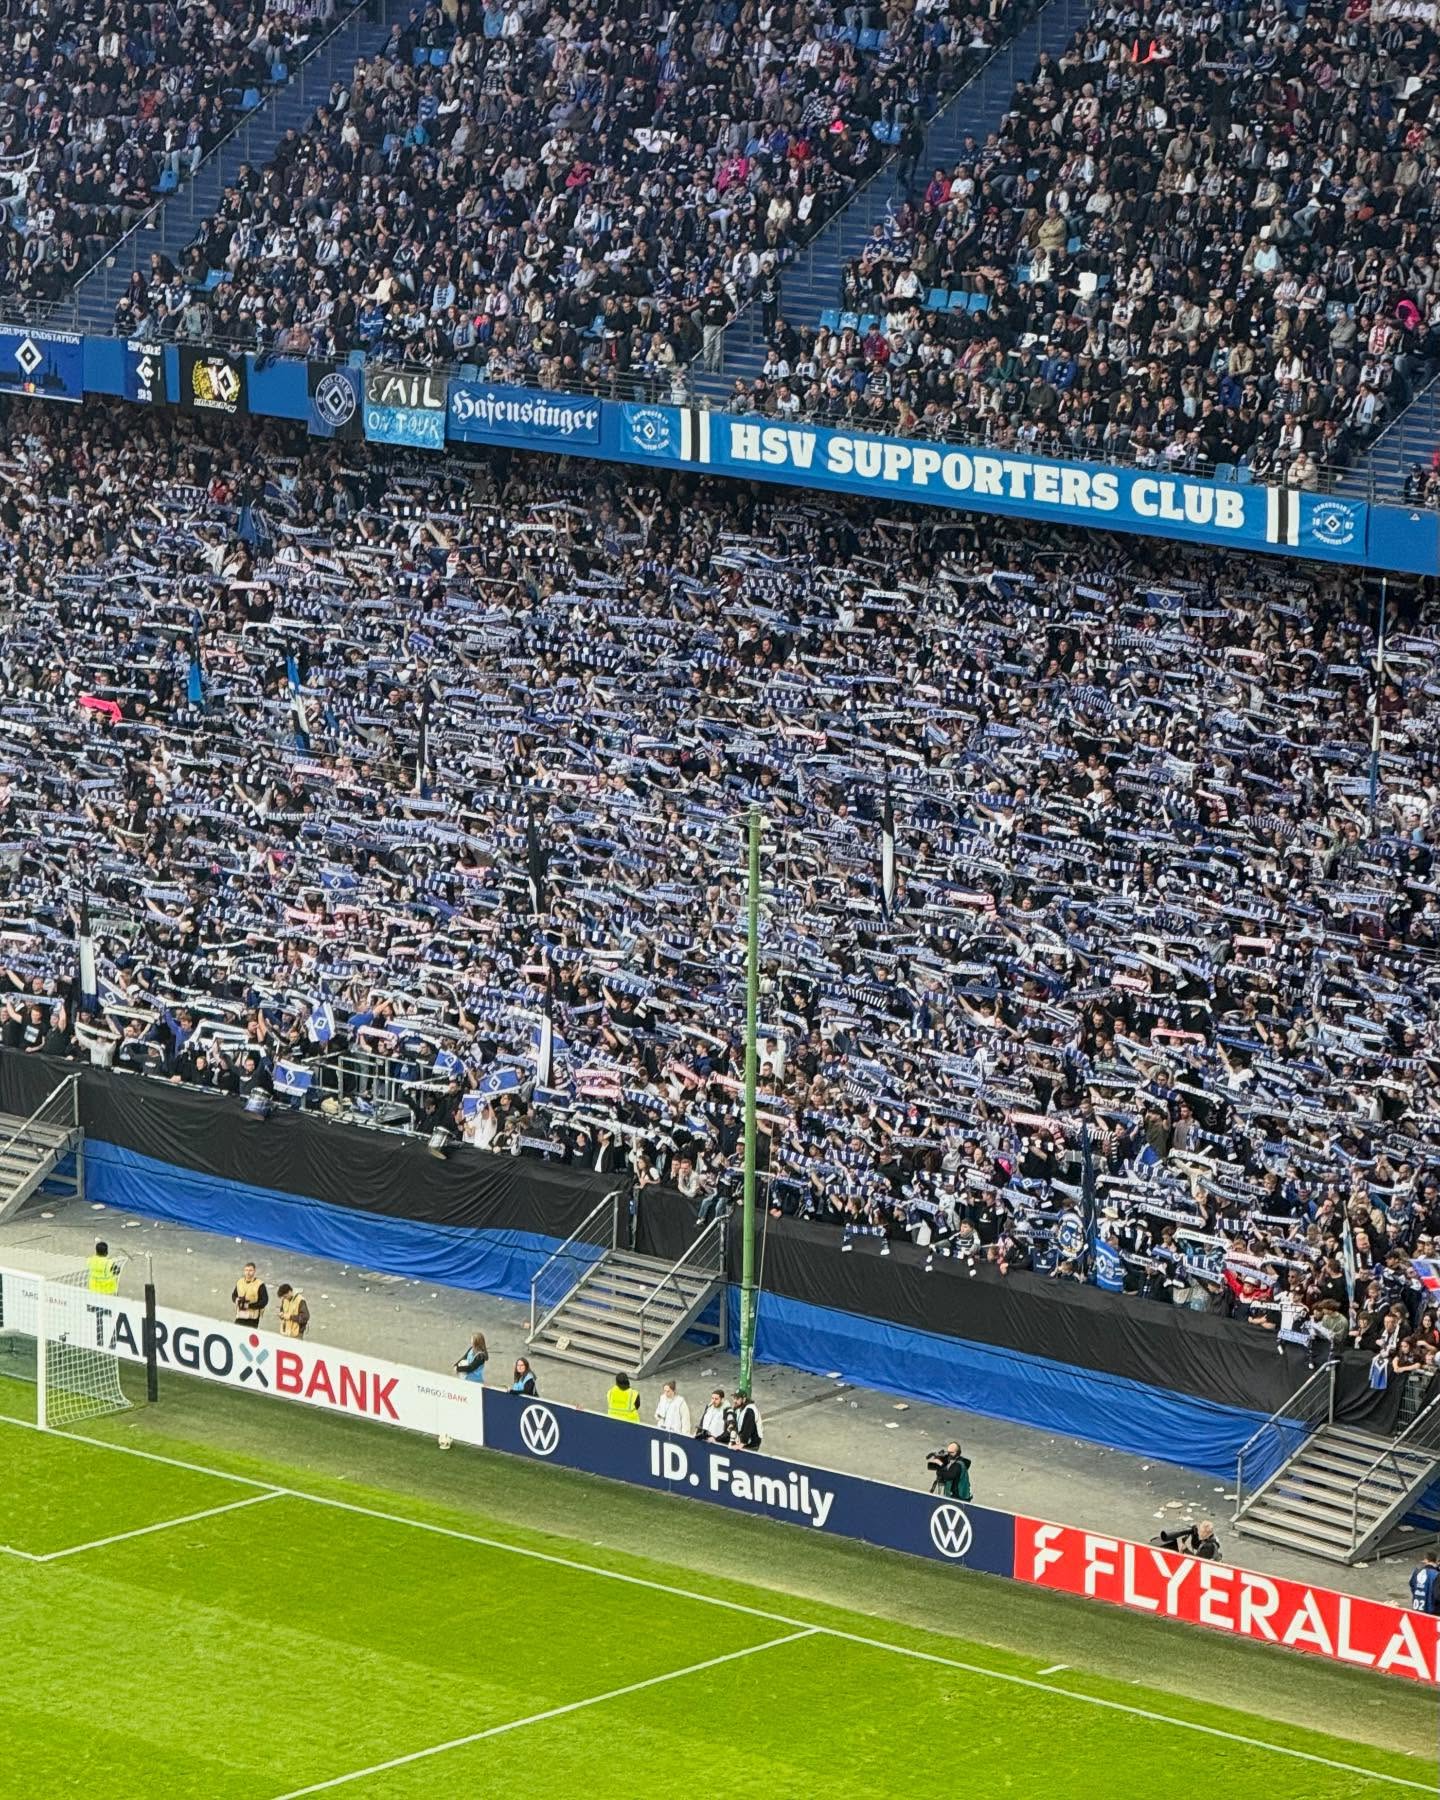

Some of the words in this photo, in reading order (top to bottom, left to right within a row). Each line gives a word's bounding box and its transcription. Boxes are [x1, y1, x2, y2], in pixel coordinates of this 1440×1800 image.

[368, 412, 391, 431] ON
[396, 413, 440, 440] TOUR
[452, 390, 599, 435] Hafensänger
[730, 423, 816, 469] HSV
[827, 436, 1119, 511] SUPPORTERS
[1130, 478, 1245, 529] CLUB
[86, 1303, 234, 1377] TARGO
[275, 1350, 400, 1420] BANK
[650, 1439, 700, 1486] ID.
[709, 1453, 835, 1528] Family
[1084, 1534, 1440, 1683] FLYERALA
